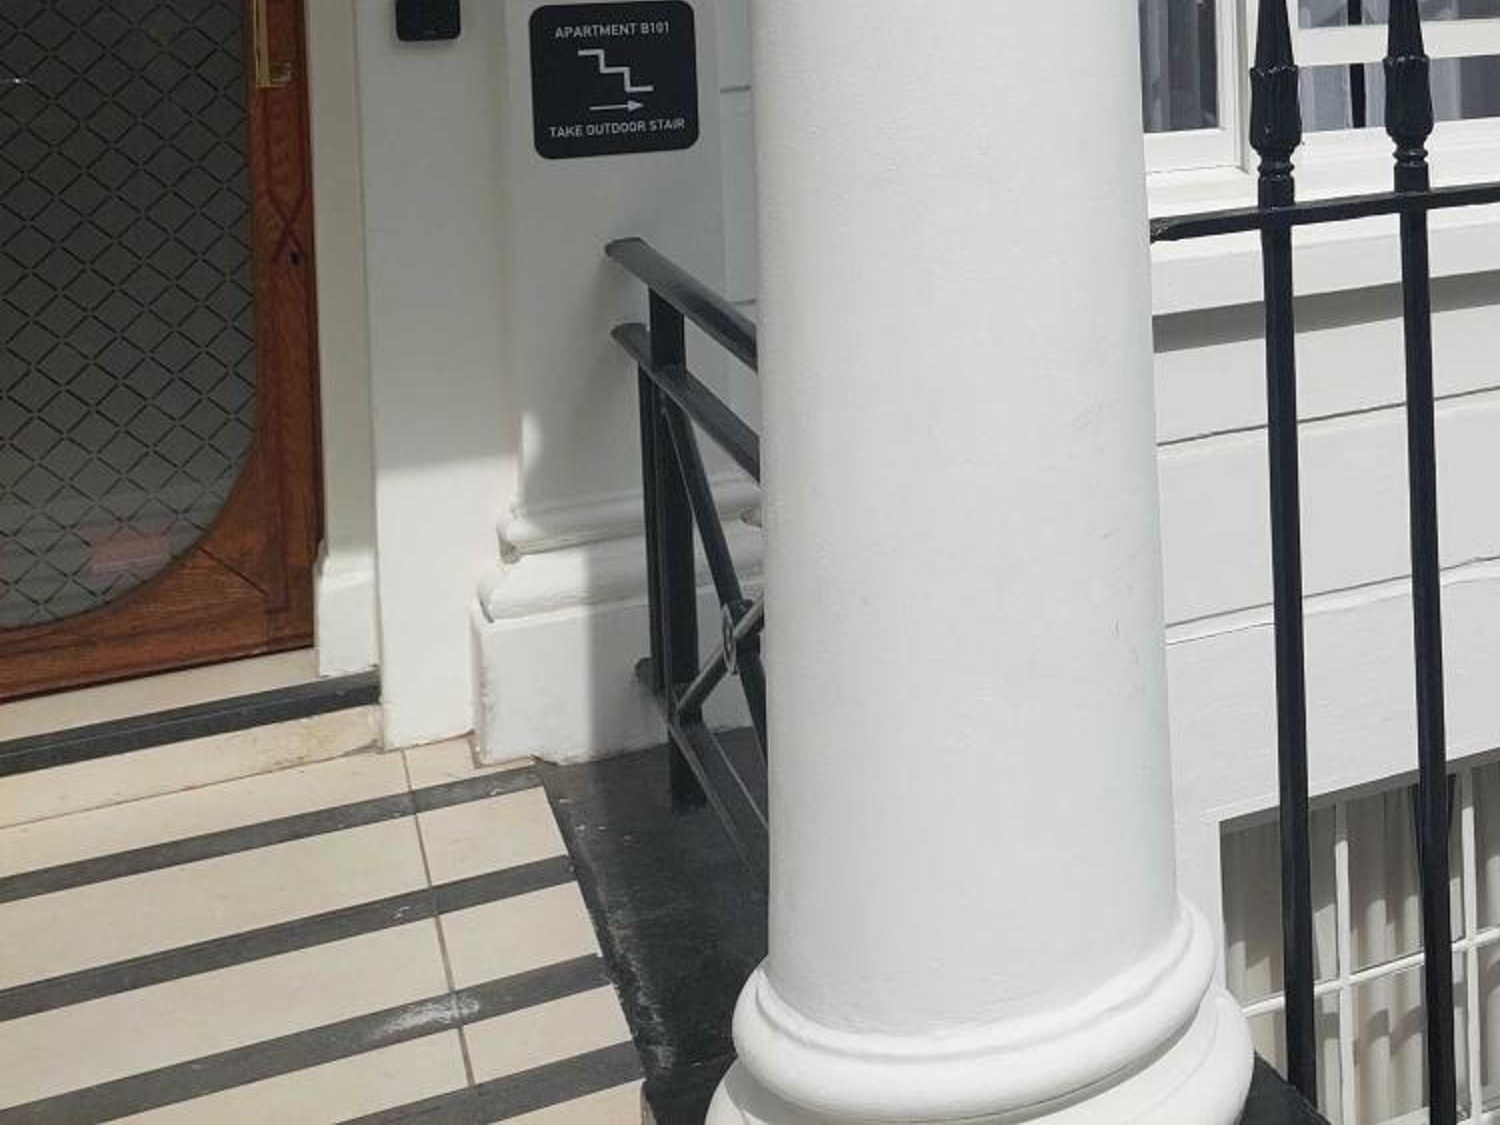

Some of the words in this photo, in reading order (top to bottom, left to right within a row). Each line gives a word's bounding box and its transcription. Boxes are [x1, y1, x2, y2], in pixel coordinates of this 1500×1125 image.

[555, 23, 637, 39] APARTMENT
[641, 21, 669, 35] B101
[550, 125, 583, 138] TAKE
[586, 121, 646, 136] OUTDOOR
[650, 118, 686, 131] STAIR
